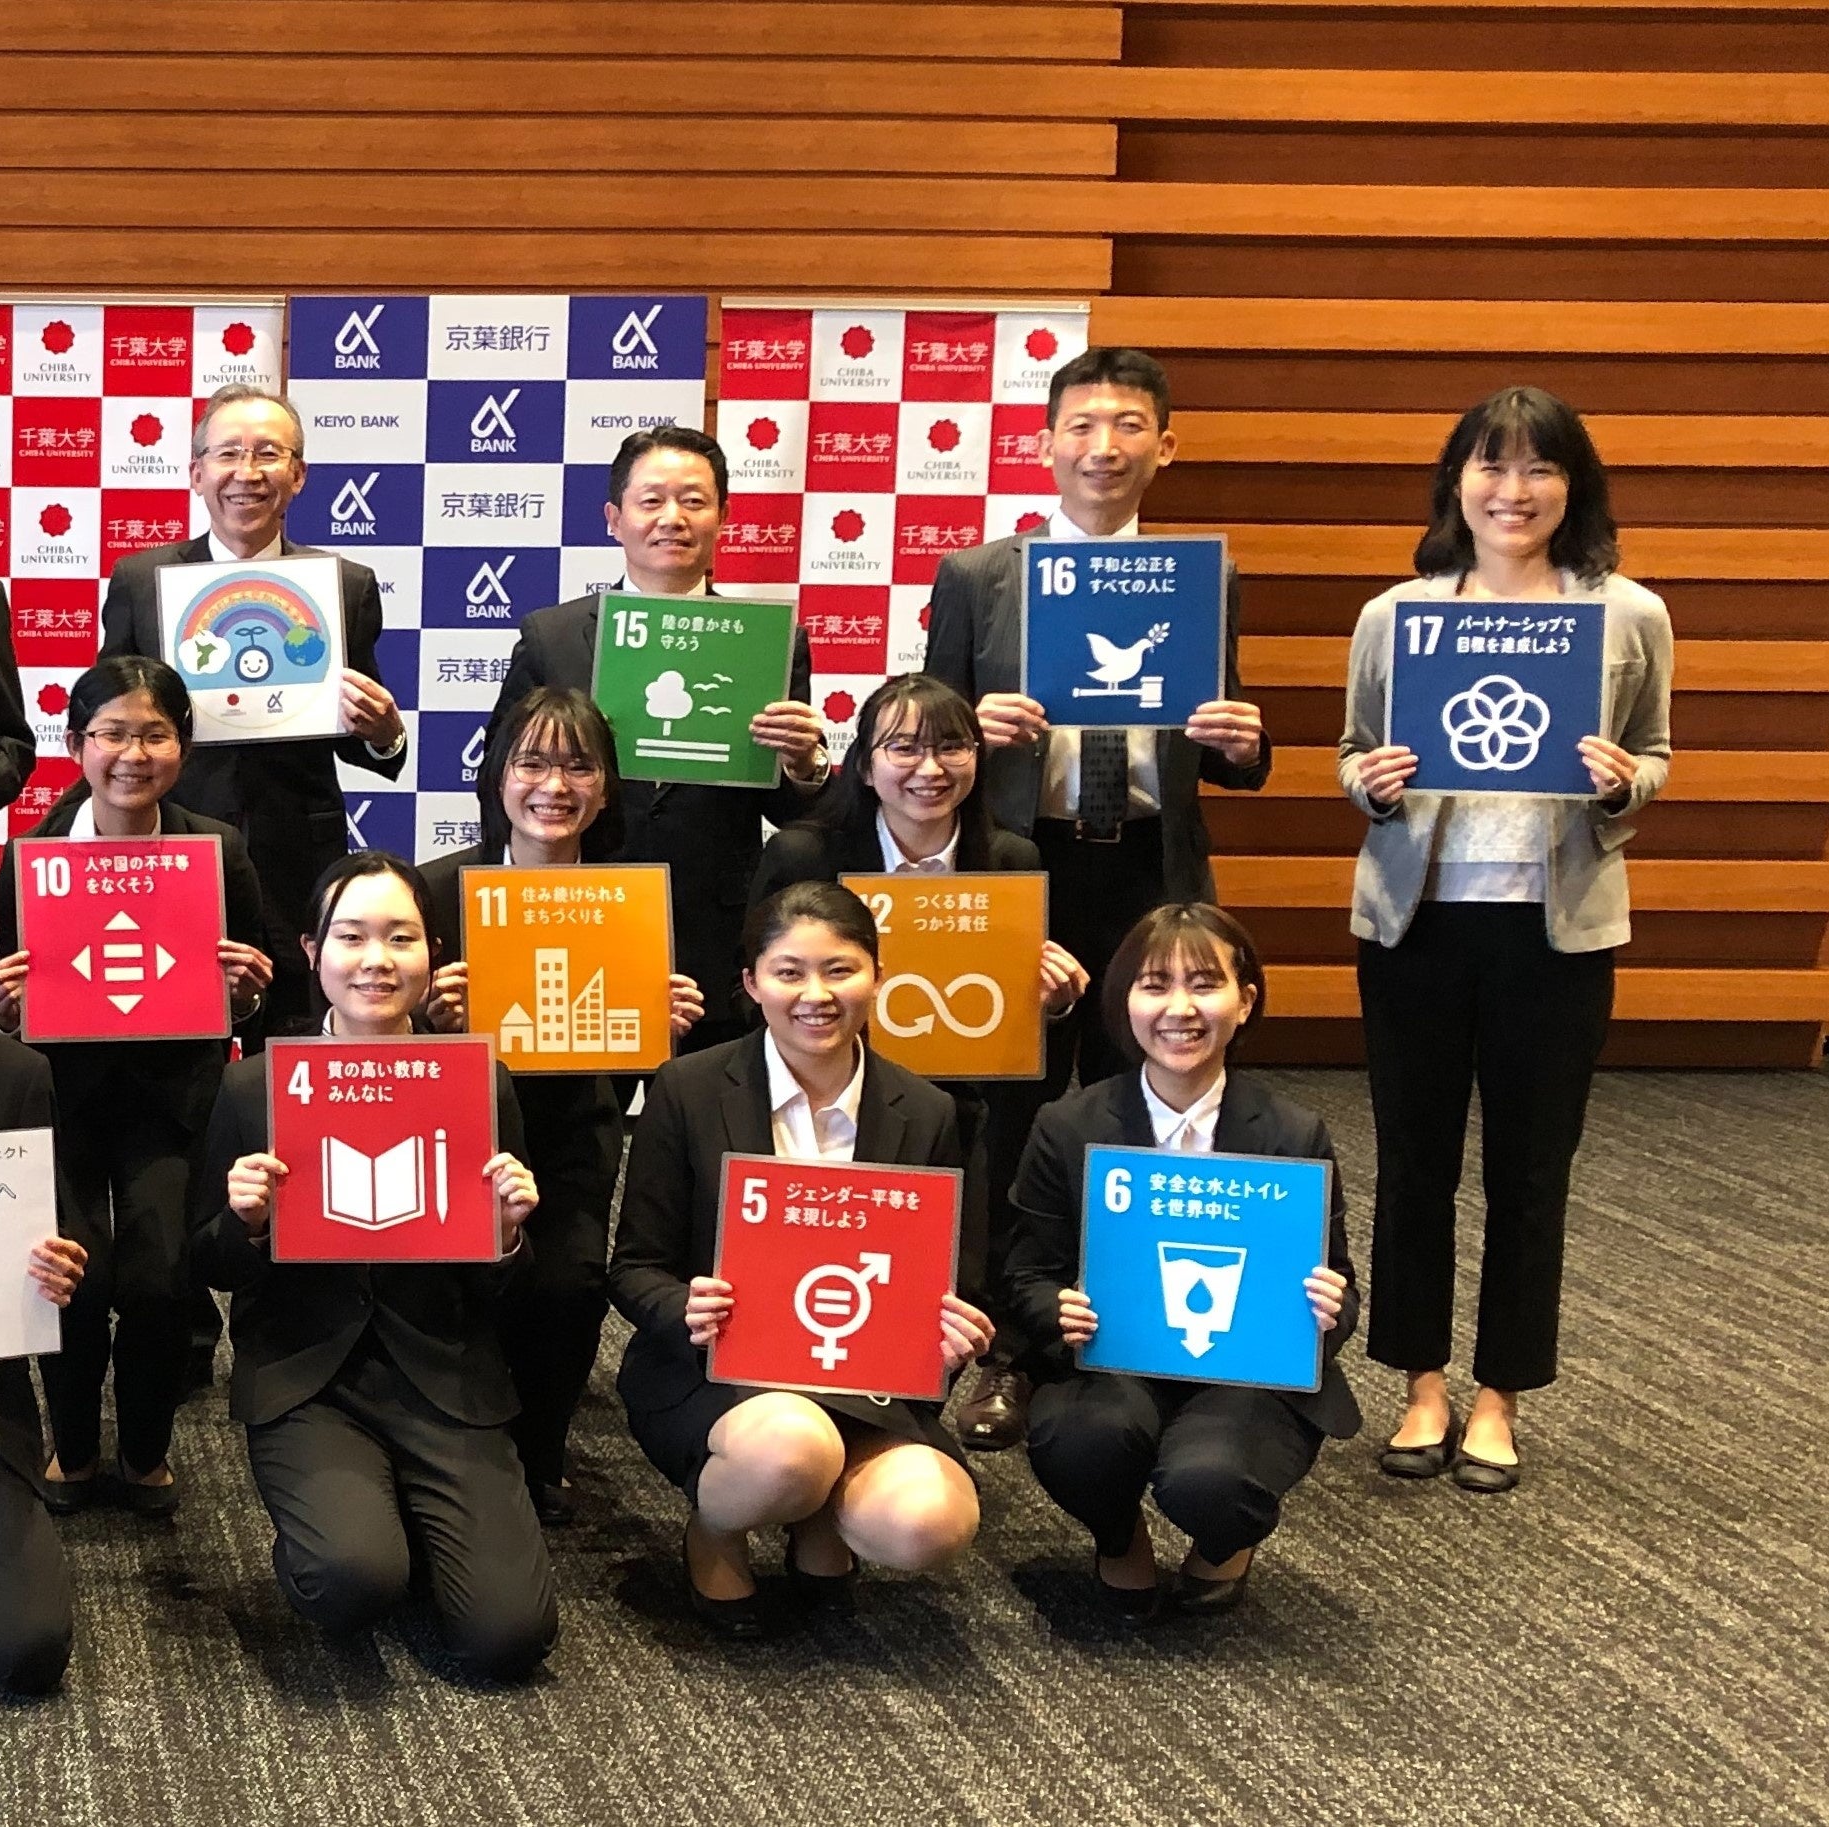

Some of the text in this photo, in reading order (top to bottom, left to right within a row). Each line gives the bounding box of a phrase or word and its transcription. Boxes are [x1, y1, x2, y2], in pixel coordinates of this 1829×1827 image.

[110, 338, 186, 357] 千葉大学
[446, 326, 550, 352] 京葉銀行
[727, 341, 805, 360] 千葉大学
[910, 342, 988, 362] 千葉大学
[40, 363, 75, 372] CHIBA
[220, 365, 255, 373] CHIBA
[335, 355, 380, 369] BANK
[613, 356, 658, 369] BANK
[24, 373, 91, 382] UNIVERSITY
[837, 368, 873, 377] CHIBA
[820, 378, 890, 386] UNIVERSITY
[315, 416, 399, 427] KEIYO BANK
[591, 416, 677, 428] KEIYO BANK
[19, 428, 95, 448] 千葉大学
[471, 438, 516, 452] BANK
[814, 433, 892, 453] 千葉大学
[128, 455, 163, 464] CHIBA
[744, 459, 780, 468] CHIBA
[924, 461, 960, 470] CHIBA
[112, 465, 180, 474] UNIVERSITY
[907, 471, 977, 480] UNIVERSITY
[441, 493, 544, 519] 京葉銀行
[107, 520, 183, 539] 千葉大学
[331, 522, 376, 535] BANK
[721, 523, 796, 543] 千葉大学
[901, 525, 978, 545] 千葉大学
[37, 546, 72, 554] CHIBA
[828, 551, 864, 560] CHIBA
[22, 555, 88, 564] UNIVERSITY
[811, 561, 881, 570] UNIVERSITY
[1089, 557, 1176, 573] 平和と公正を
[1037, 557, 1076, 595] 16
[1089, 580, 1176, 594] すべての人に
[18, 609, 92, 628] 千葉大学
[466, 605, 511, 619] BANK
[613, 610, 648, 648] 15
[661, 614, 744, 634] 陸の豊かさも
[805, 615, 882, 635] 千葉大学
[1457, 616, 1576, 632] パートナーシップで
[661, 634, 699, 651] 守ろう
[1405, 616, 1444, 655] 17
[1457, 637, 1570, 655] 目標を達成しよう
[437, 659, 512, 682] 京葉銀
[85, 855, 189, 872] 人や国の不平等
[31, 857, 70, 896] 10
[86, 876, 155, 894] をなくそう
[522, 886, 626, 903] 住み続けられる
[914, 893, 989, 910] つくる責任
[476, 886, 507, 926] 11
[860, 893, 893, 934] 2
[523, 908, 605, 925] まちづくりを
[914, 916, 988, 932] つかう責任
[327, 1060, 441, 1079] 質の高い教育を
[288, 1061, 313, 1104] 4
[328, 1085, 393, 1102] みんなに
[1105, 1168, 1132, 1213] 6
[1149, 1172, 1288, 1201] 安全な水とトイレ
[742, 1177, 767, 1223] 5
[784, 1182, 921, 1211] ジェンダー平等を
[783, 1206, 867, 1229] 実現しよう
[1150, 1198, 1241, 1220] を世界中に
